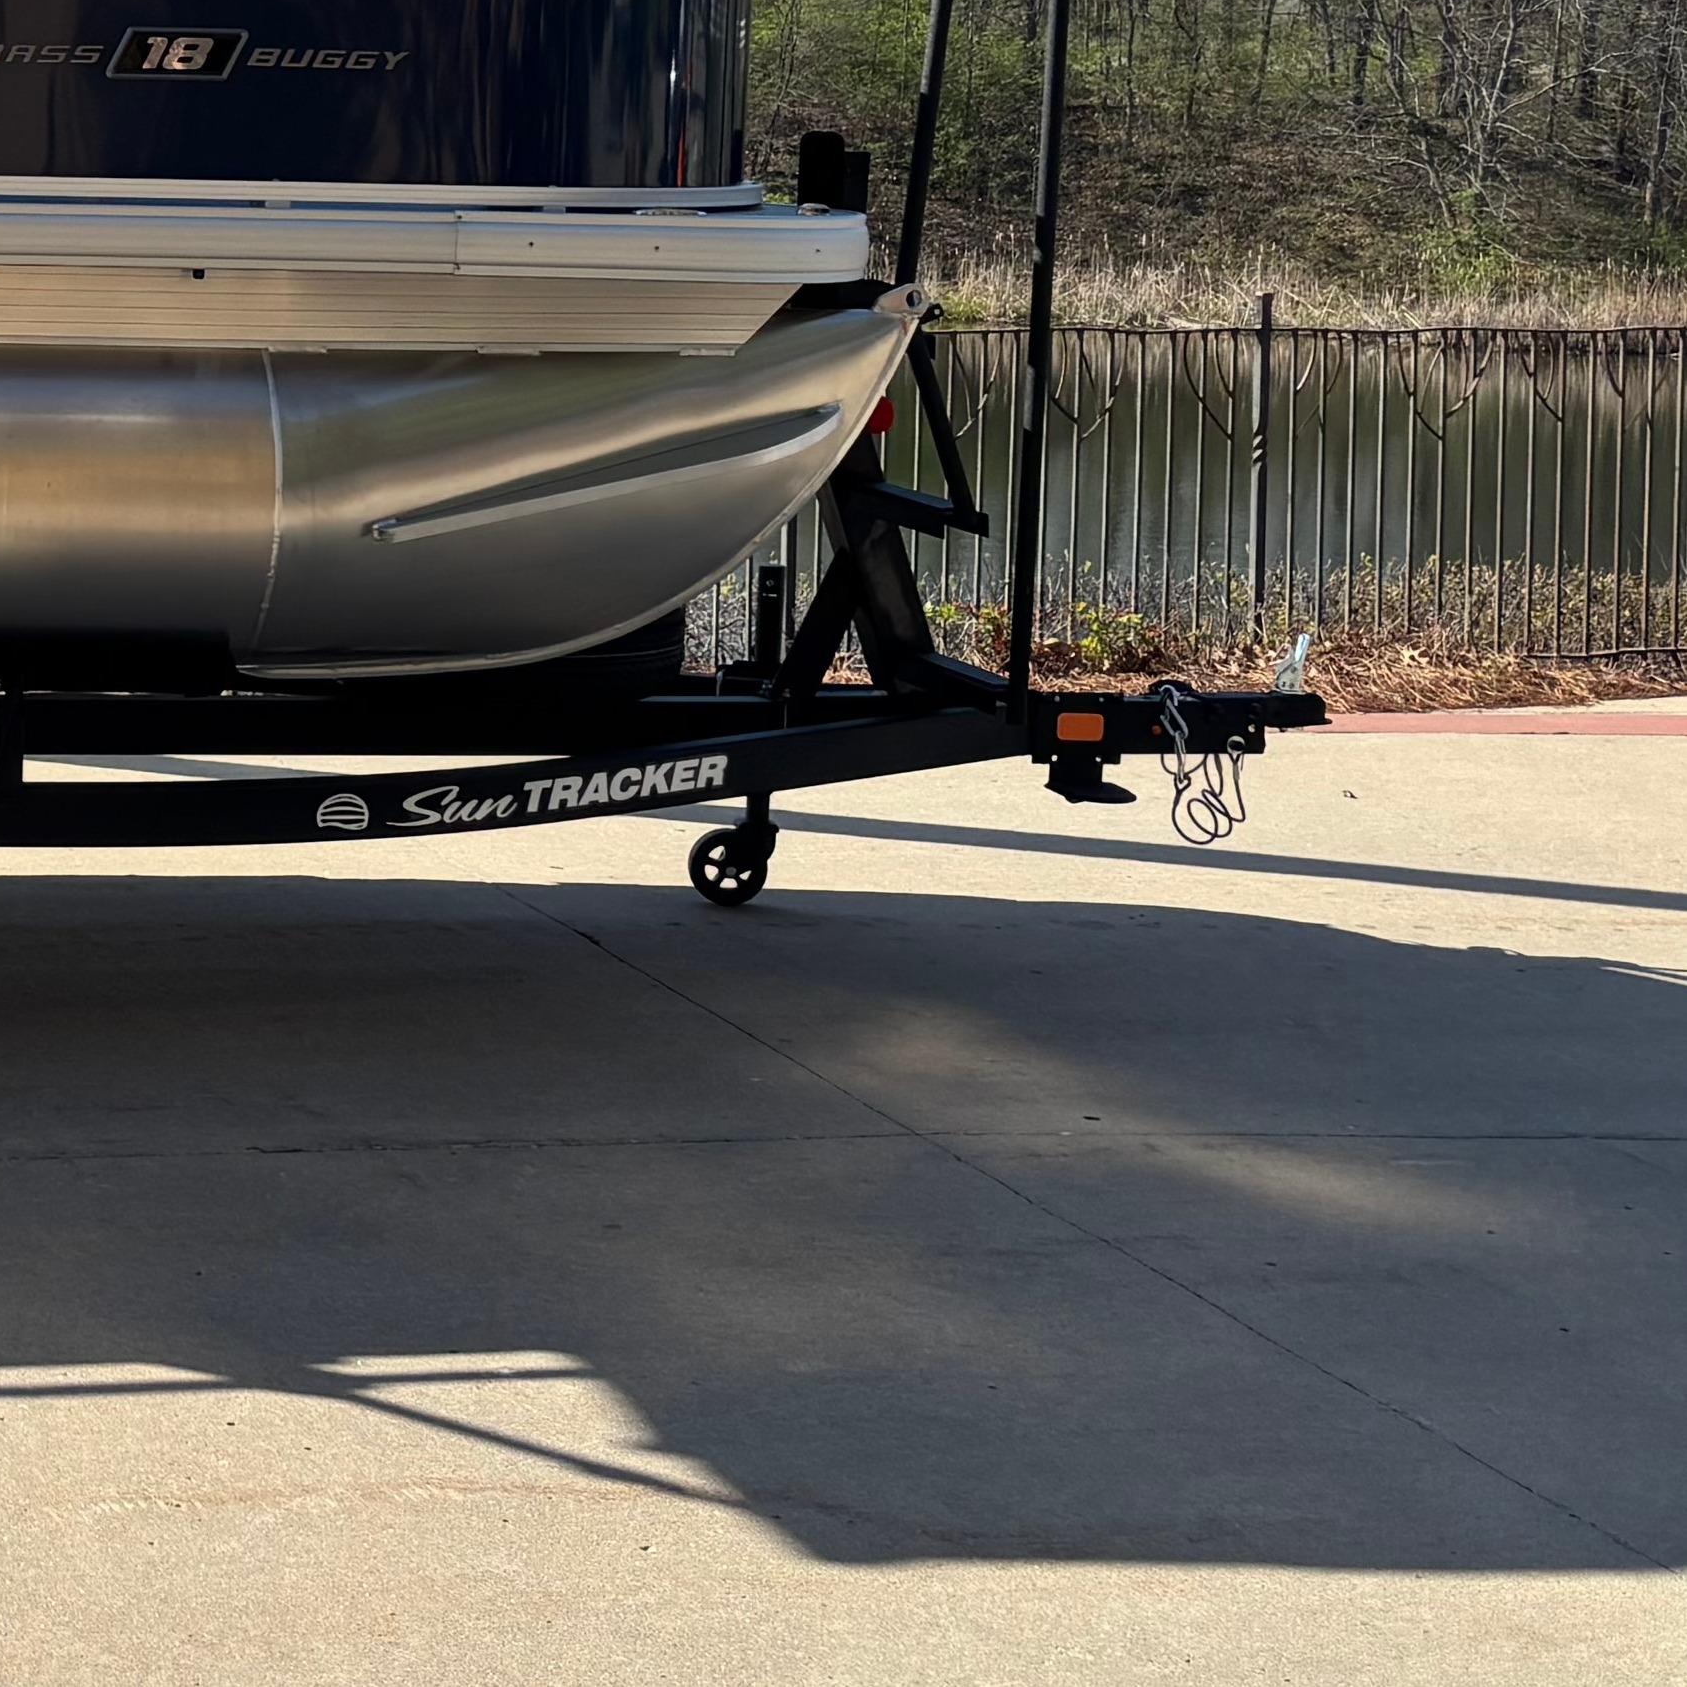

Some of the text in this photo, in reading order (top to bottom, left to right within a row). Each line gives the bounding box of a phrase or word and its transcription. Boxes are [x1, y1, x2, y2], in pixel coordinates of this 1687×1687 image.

[141, 36, 214, 71] 18
[247, 47, 410, 71] BUGGY
[385, 755, 727, 827] Sun TRACKER
